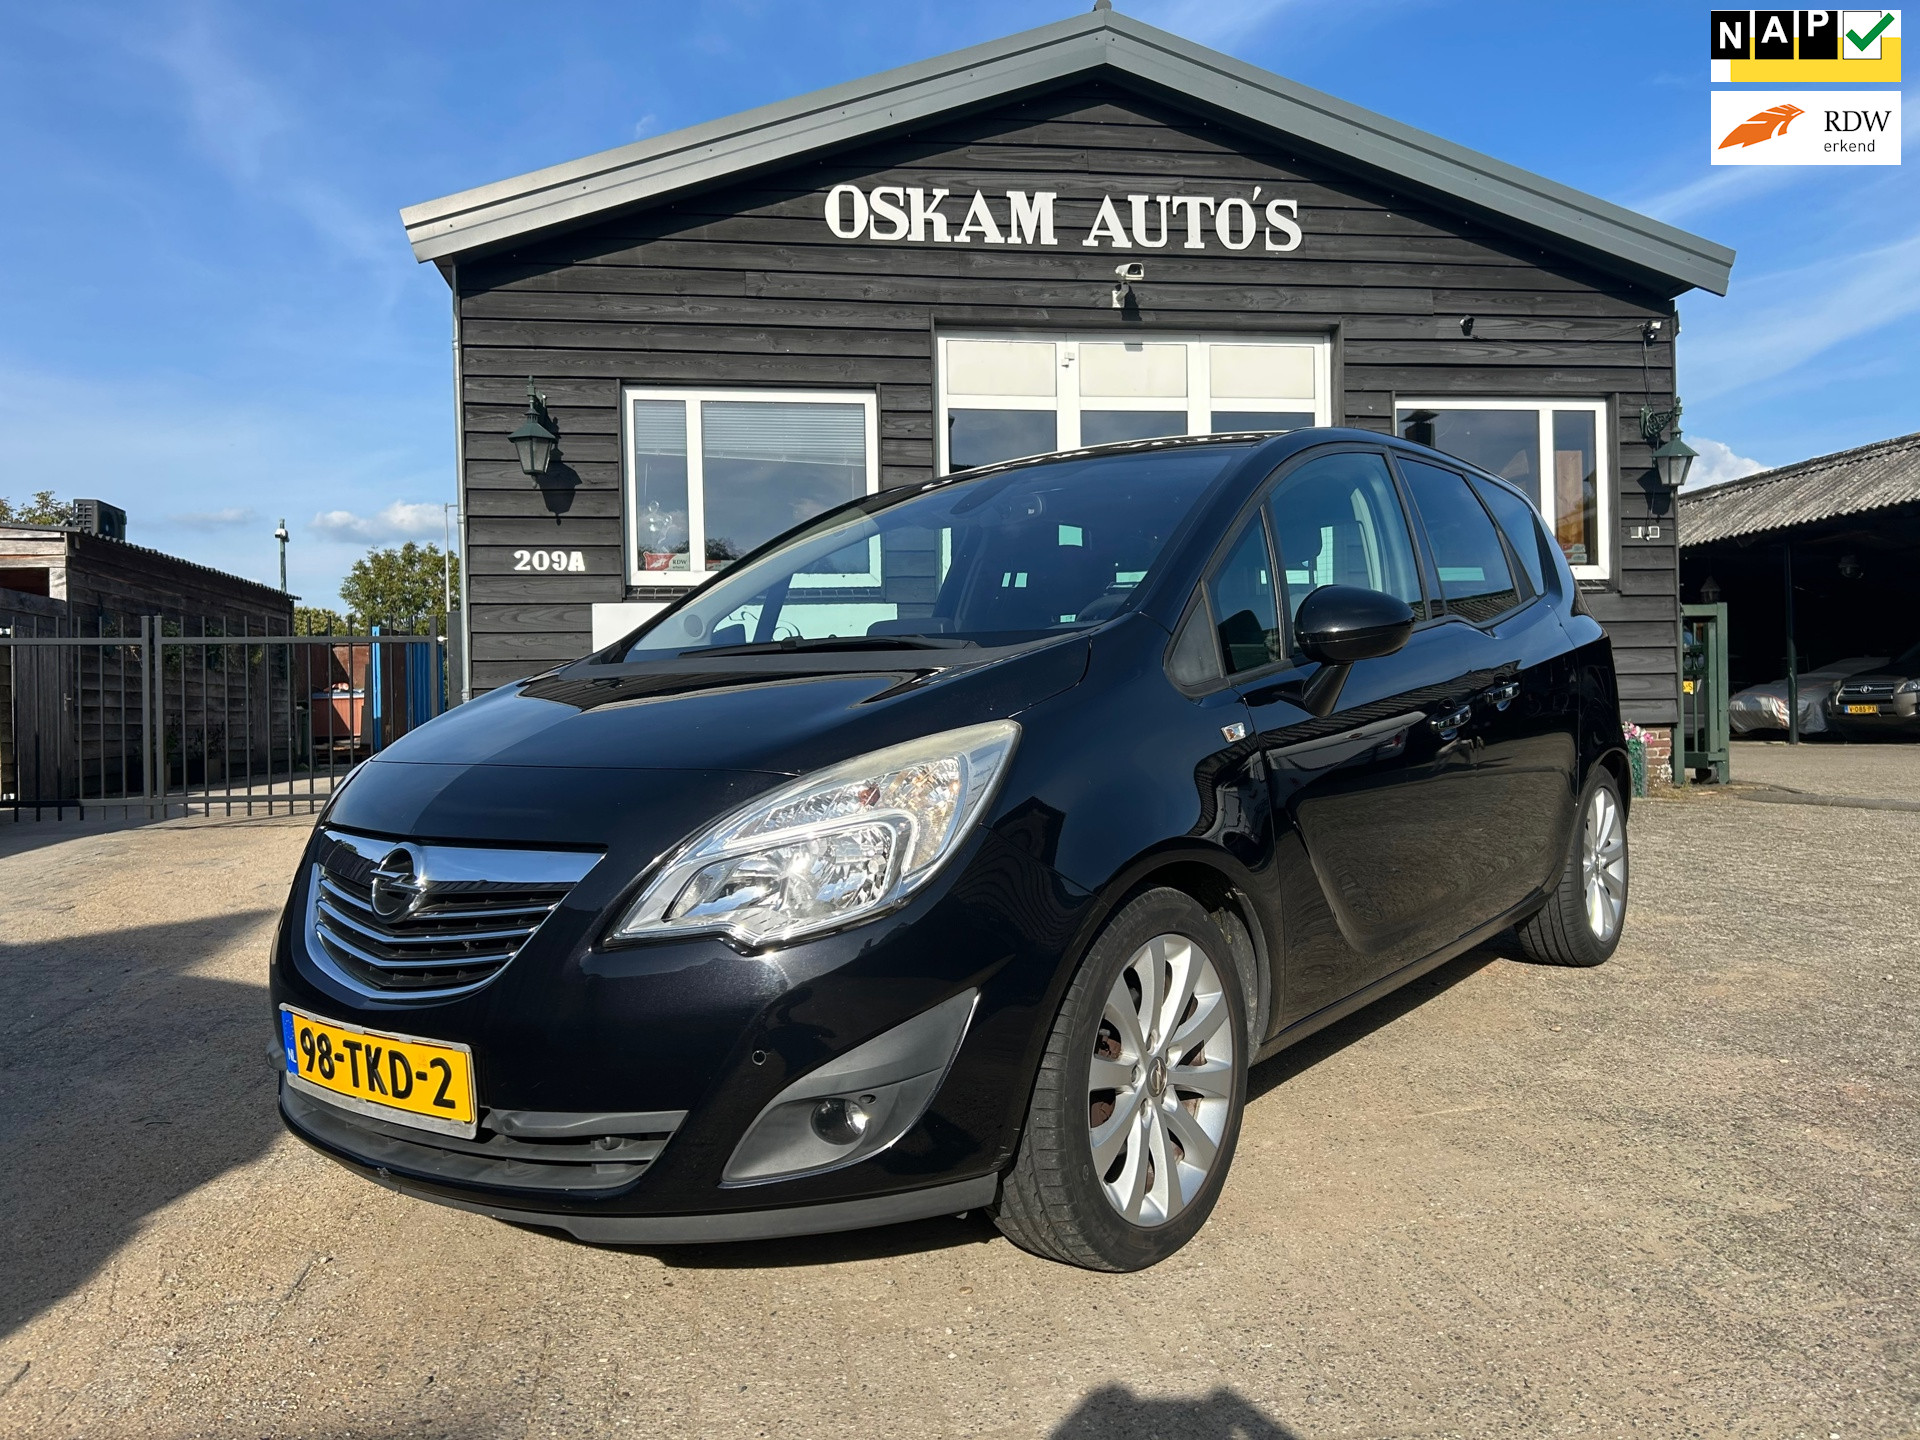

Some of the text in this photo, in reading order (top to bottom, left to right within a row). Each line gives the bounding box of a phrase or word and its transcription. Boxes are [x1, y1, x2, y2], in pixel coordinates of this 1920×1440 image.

[824, 184, 1058, 246] OSKAM
[513, 549, 586, 572] 209A
[287, 1047, 297, 1063] NL
[299, 1026, 457, 1110] 98-TKD-2
